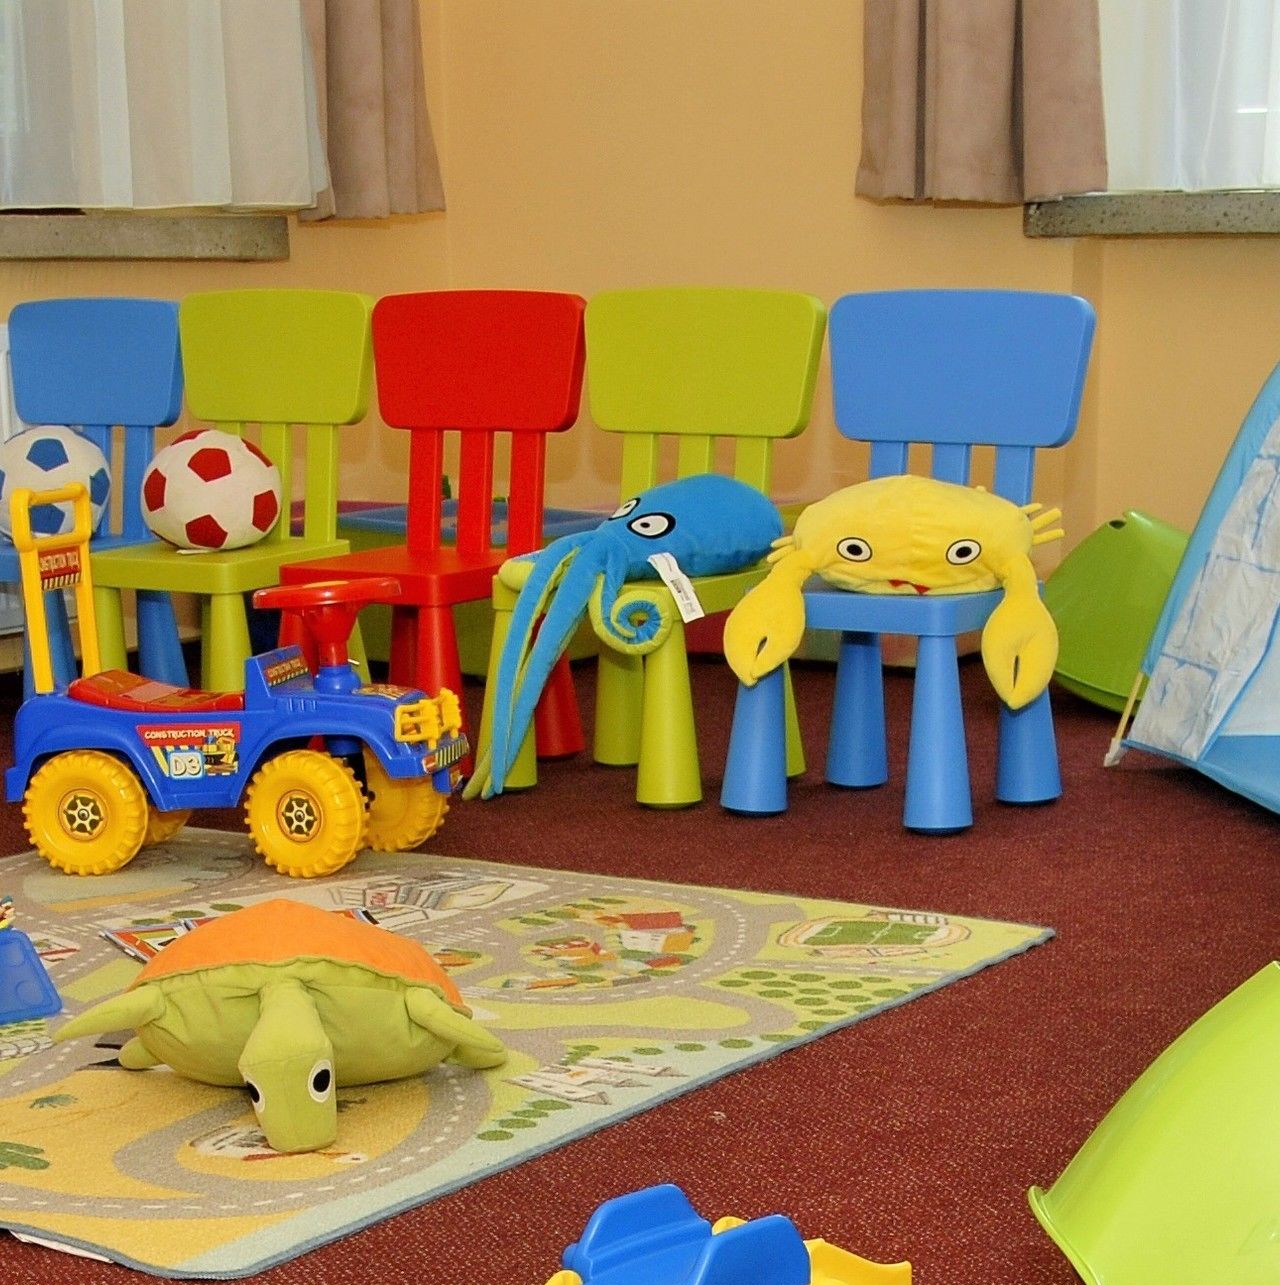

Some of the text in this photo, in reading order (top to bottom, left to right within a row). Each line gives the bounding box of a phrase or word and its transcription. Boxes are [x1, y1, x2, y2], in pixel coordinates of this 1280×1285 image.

[144, 728, 235, 740] CONSTRUCTION TRUCK
[173, 755, 201, 776] D3
